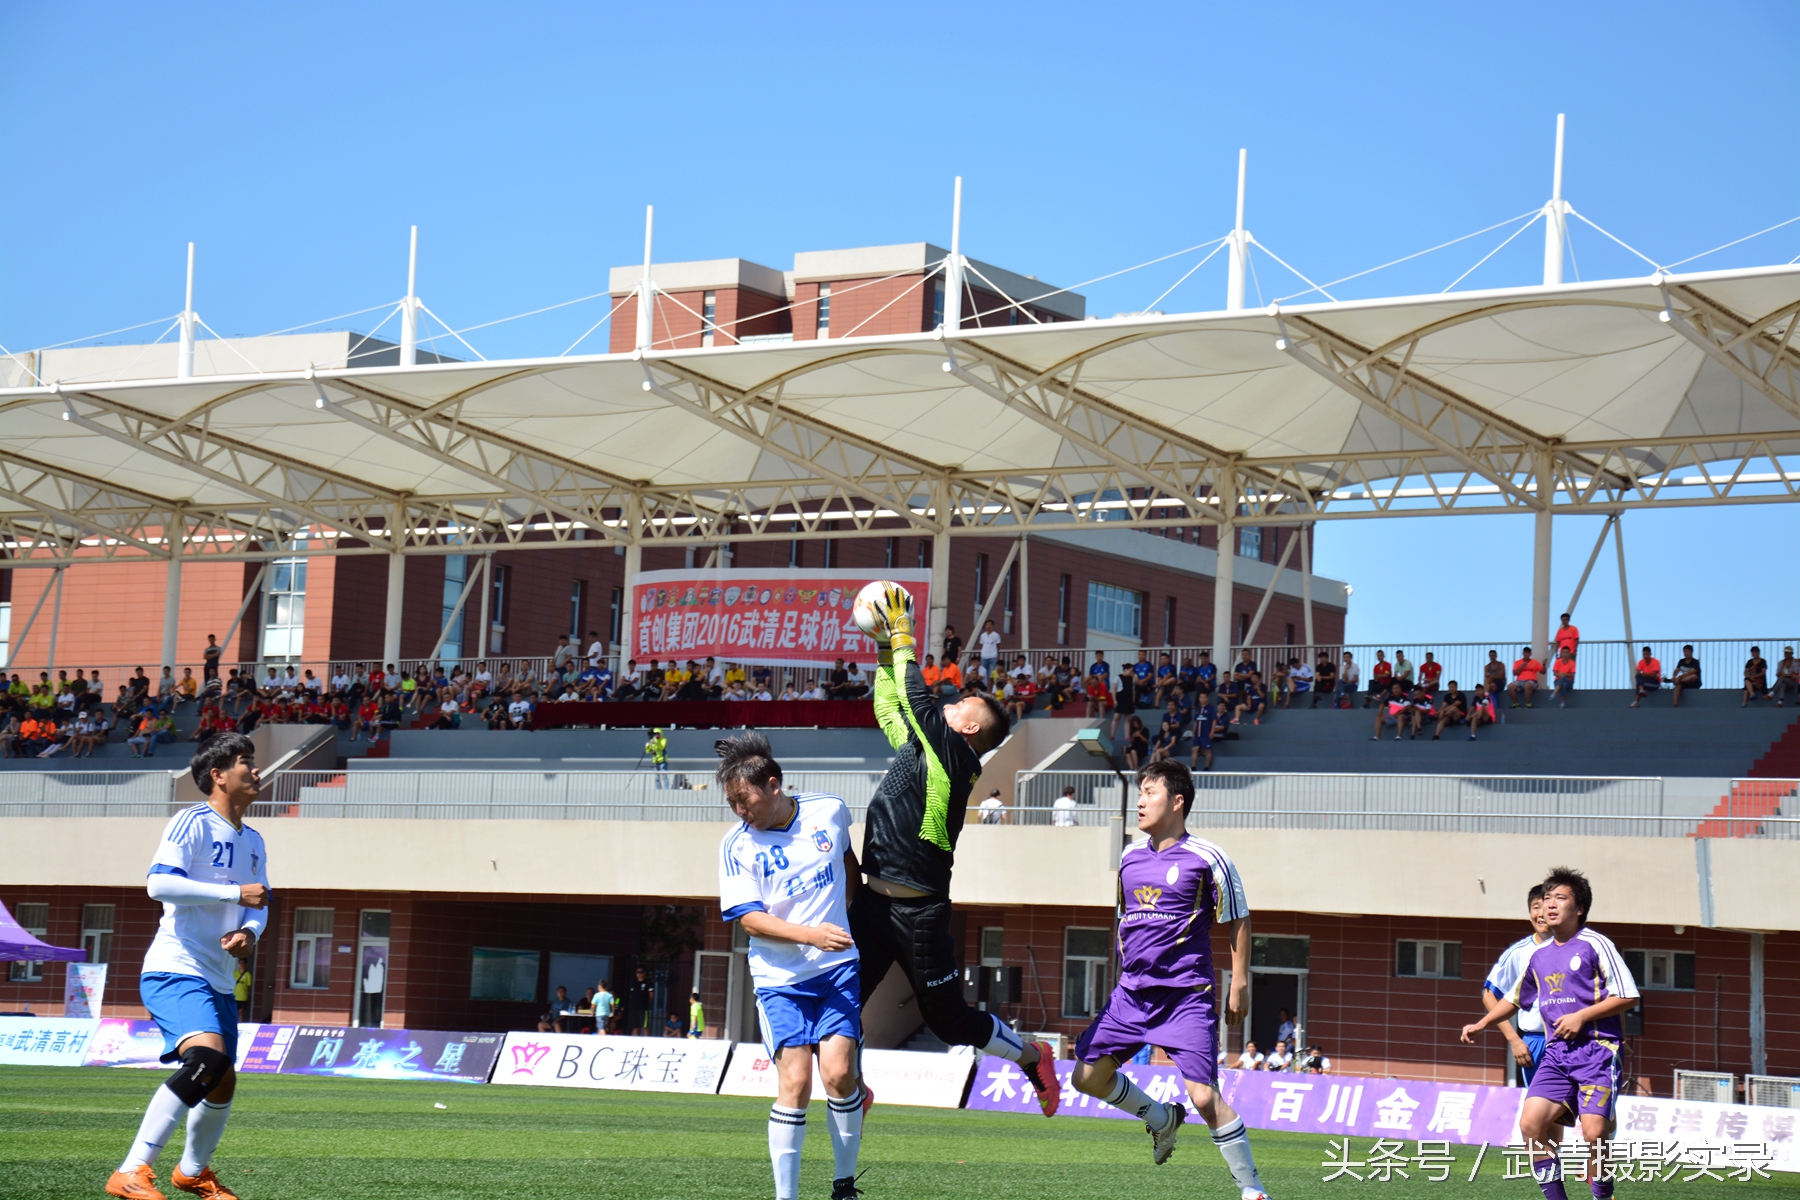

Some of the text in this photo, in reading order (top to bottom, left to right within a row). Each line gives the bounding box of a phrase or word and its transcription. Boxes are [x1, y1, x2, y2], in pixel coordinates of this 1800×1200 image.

[212, 841, 234, 869] 27
[755, 845, 790, 878] 28
[926, 975, 953, 988] KELME
[309, 1036, 467, 1073] 闪亮之星
[1269, 1081, 1477, 1136] 百川金属
[1579, 1085, 1613, 1108] 77
[1625, 1105, 1797, 1143] 海洋传媒
